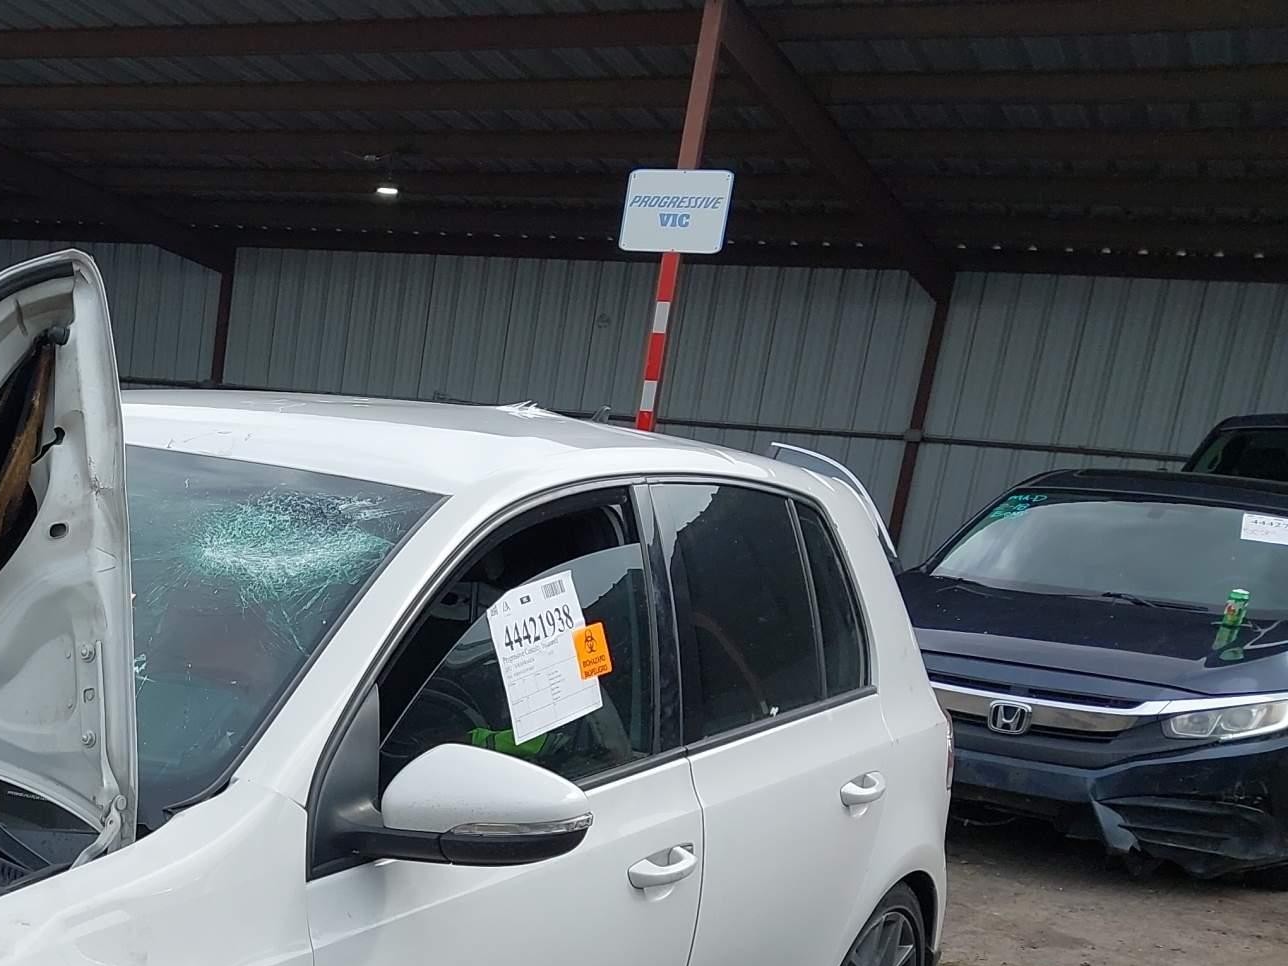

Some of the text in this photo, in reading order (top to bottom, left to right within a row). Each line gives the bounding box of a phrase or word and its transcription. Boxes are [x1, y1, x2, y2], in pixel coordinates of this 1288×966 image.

[629, 195, 724, 209] PROGRESSIVE
[659, 213, 690, 228] VIC
[504, 603, 574, 651] 44421938
